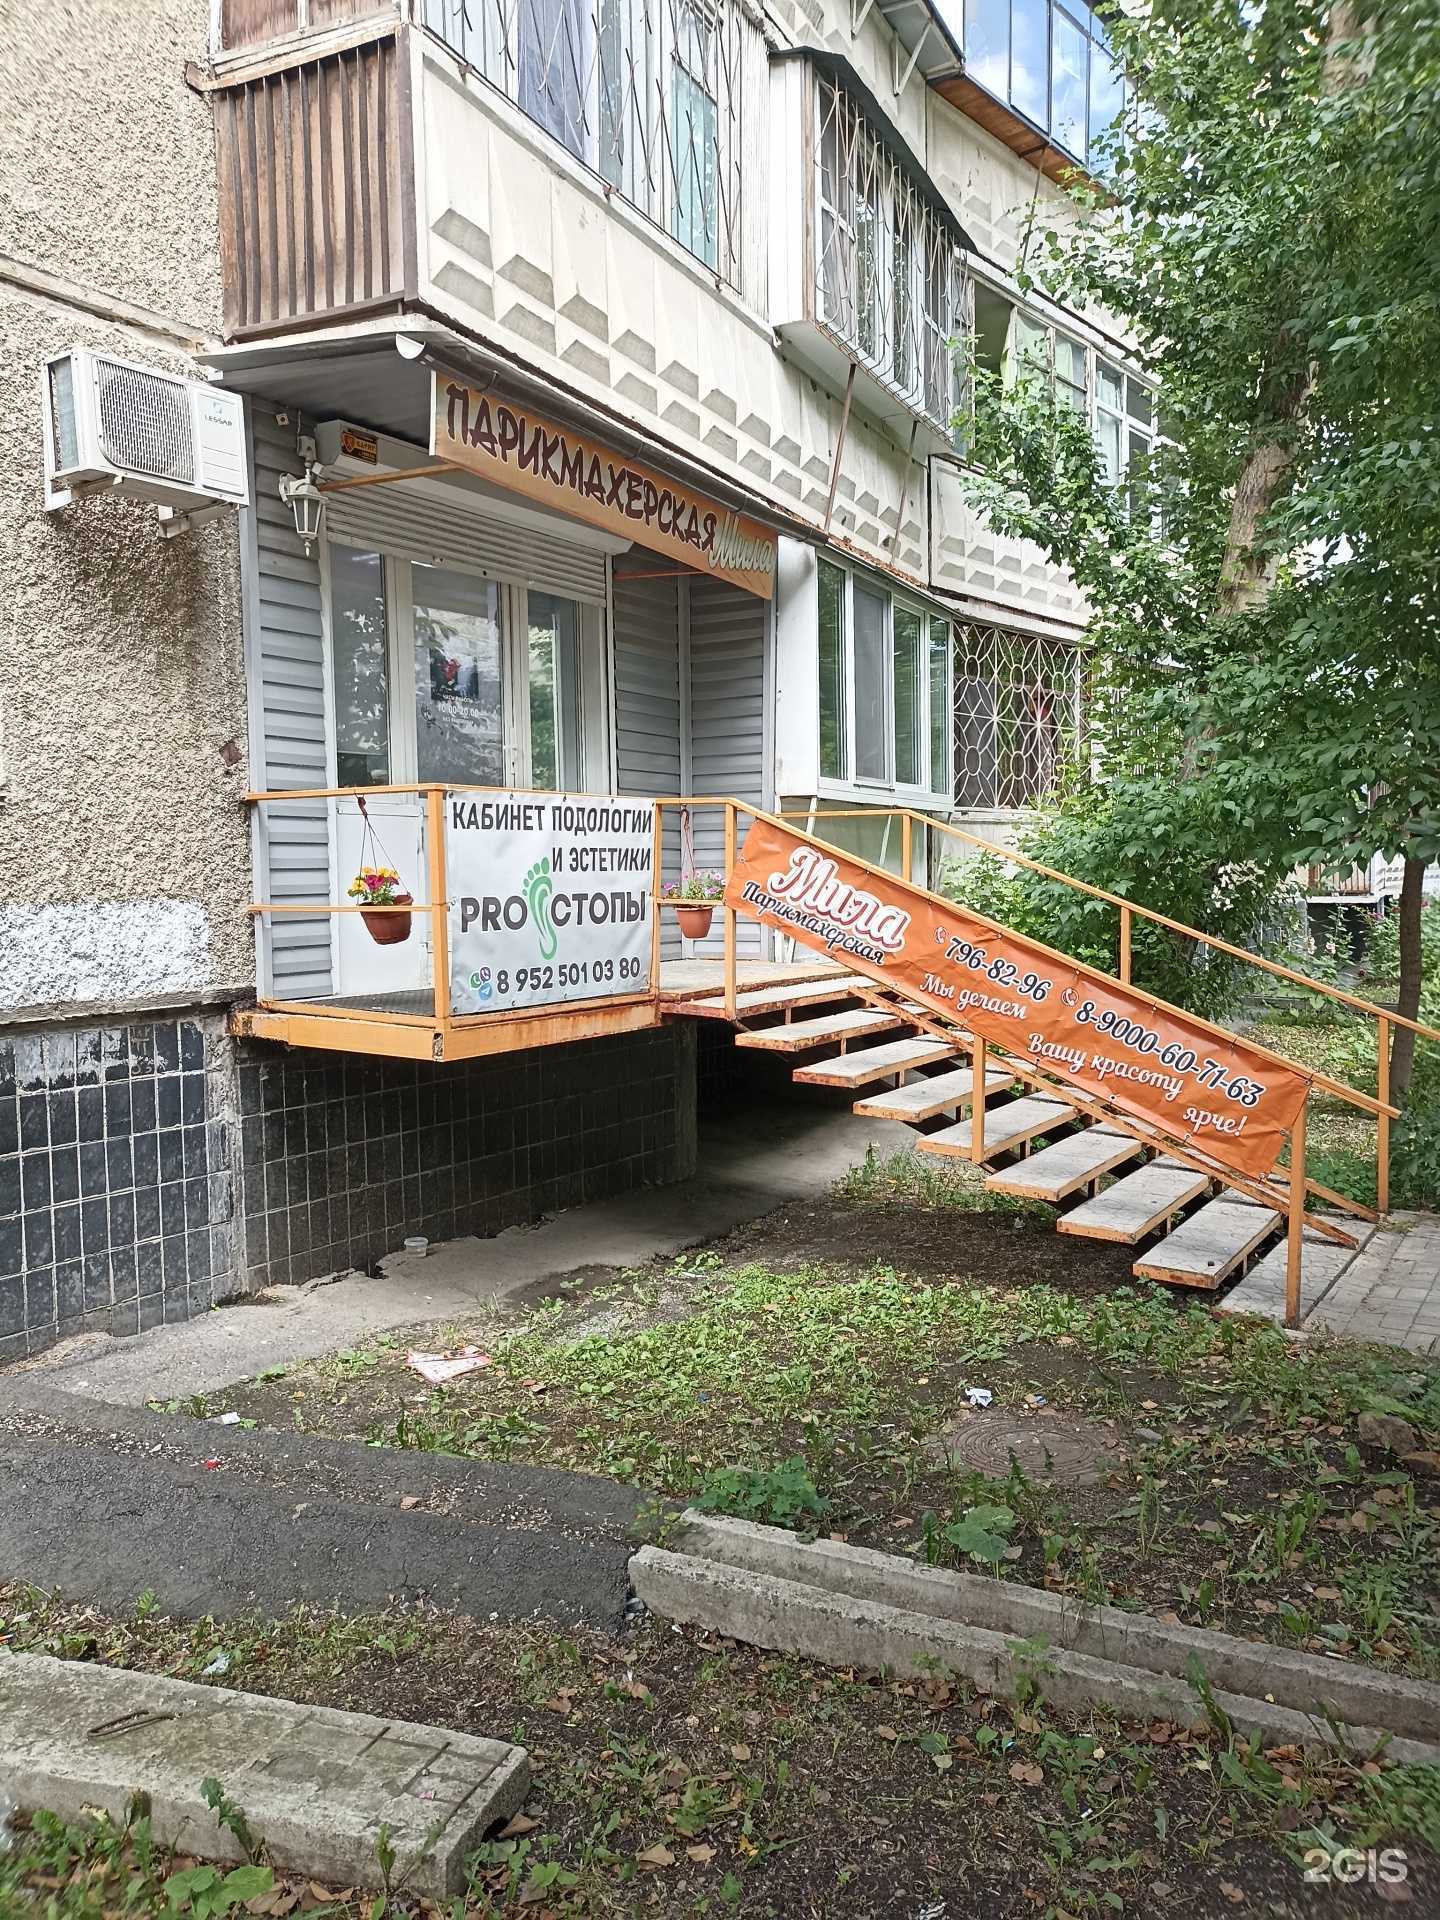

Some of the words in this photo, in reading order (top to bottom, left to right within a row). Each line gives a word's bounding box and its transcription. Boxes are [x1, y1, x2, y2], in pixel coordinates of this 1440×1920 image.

[445, 382, 717, 552] ПАРИКМАХЕРСКАЯ
[452, 802, 546, 831] КАБИНЕТ
[551, 806, 653, 836] ПОДОЛОГИИ
[552, 847, 563, 872] И
[569, 847, 651, 872] ЭСТЕТИКИ
[461, 894, 528, 933] PRO
[550, 891, 647, 927] СТОПЫ
[742, 880, 885, 966] Парикмахерская
[768, 846, 912, 951] Мила
[496, 969, 510, 994] 8
[515, 965, 554, 992] 952
[558, 961, 588, 987] 501
[592, 958, 614, 984] 03
[619, 956, 641, 978] 80
[919, 973, 955, 999] Мы
[956, 988, 1028, 1020] делаем
[945, 936, 1053, 1002] 796-82-96
[1027, 1031, 1087, 1074] Вашу
[1090, 1054, 1185, 1102] красоту
[1074, 1000, 1266, 1109] 8-9000-60-71-63
[1182, 1104, 1249, 1138] ярче!
